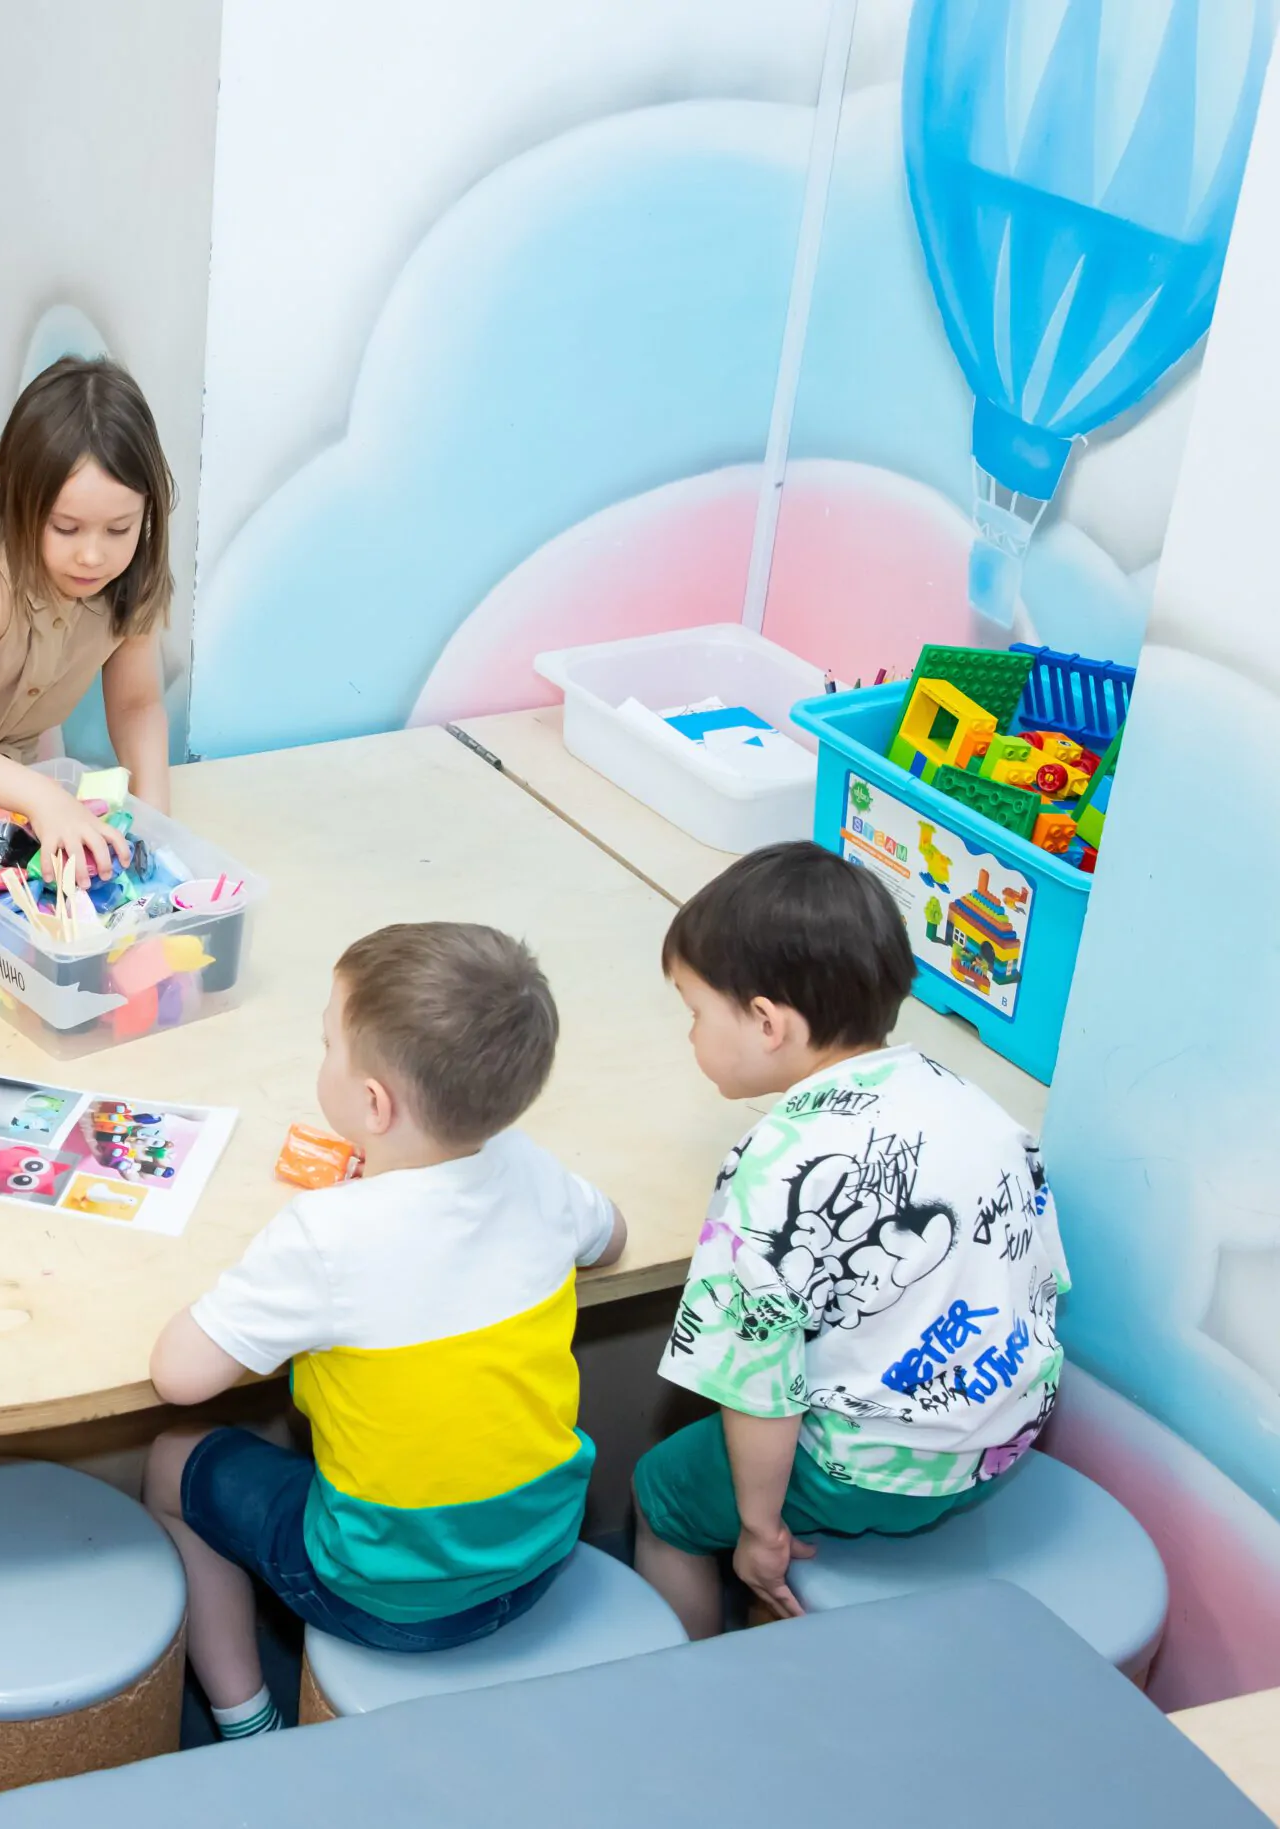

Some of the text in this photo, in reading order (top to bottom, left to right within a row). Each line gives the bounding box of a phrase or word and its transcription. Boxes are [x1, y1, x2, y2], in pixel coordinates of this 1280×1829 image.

[853, 816, 908, 862] STEAM
[786, 1088, 879, 1113] SO WHAT?
[880, 1299, 1000, 1396] BETTER
